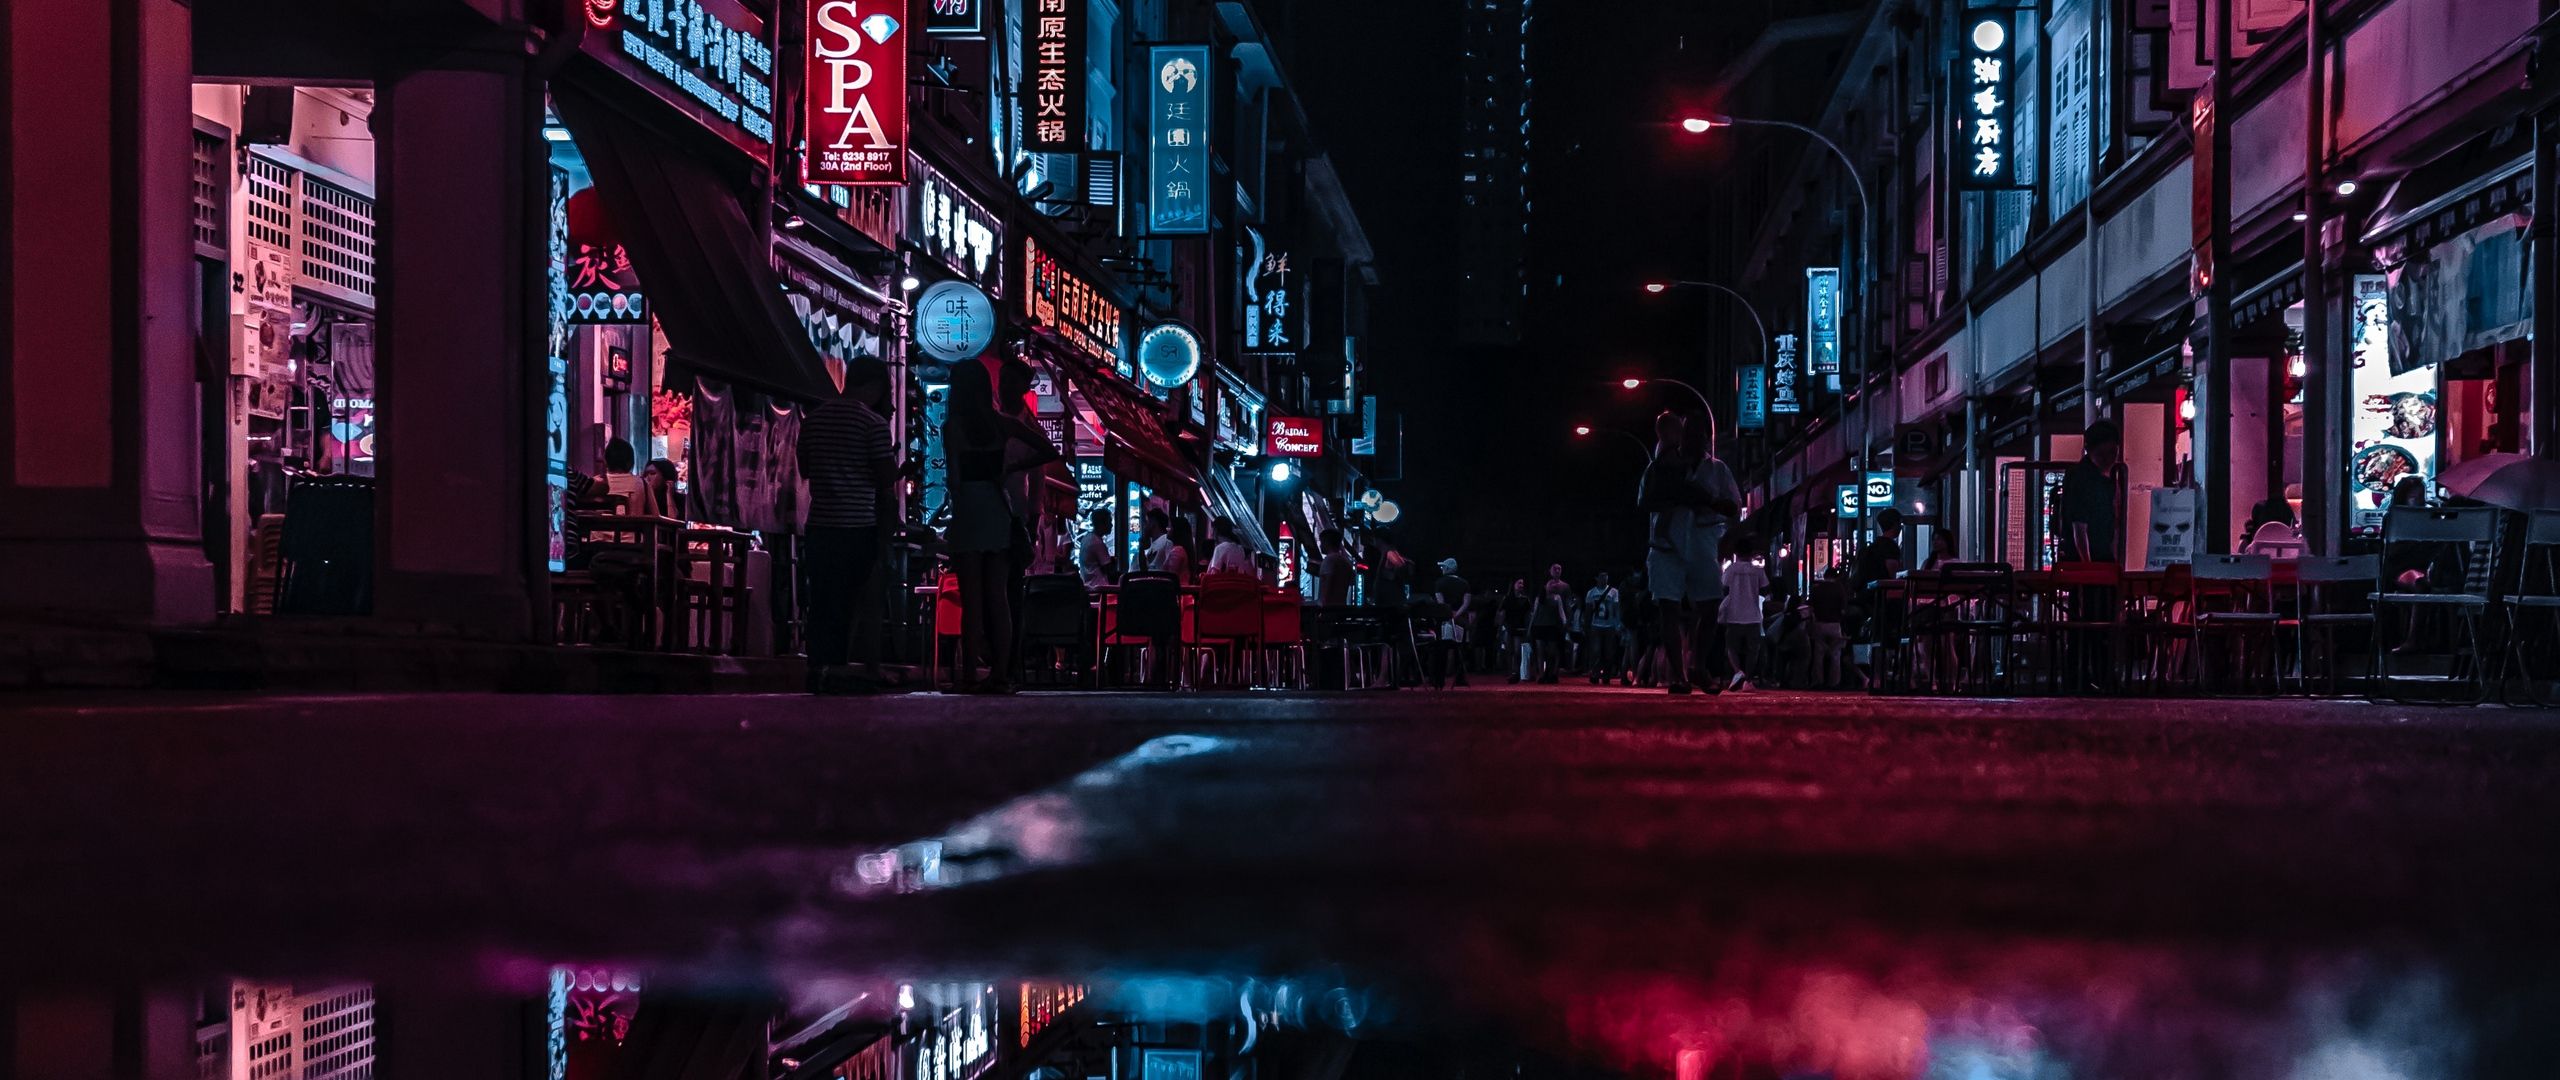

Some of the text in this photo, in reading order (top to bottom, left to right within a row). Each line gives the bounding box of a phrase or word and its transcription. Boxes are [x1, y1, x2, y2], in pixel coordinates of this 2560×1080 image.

[815, 1, 898, 149] SPA
[822, 152, 889, 161] Tel: 6238 8917
[820, 161, 892, 172] 30A (2nd Floor)
[1271, 421, 1309, 436] BRIDAL
[1275, 437, 1318, 452] CONCEPT
[1867, 485, 1891, 495] NO.1
